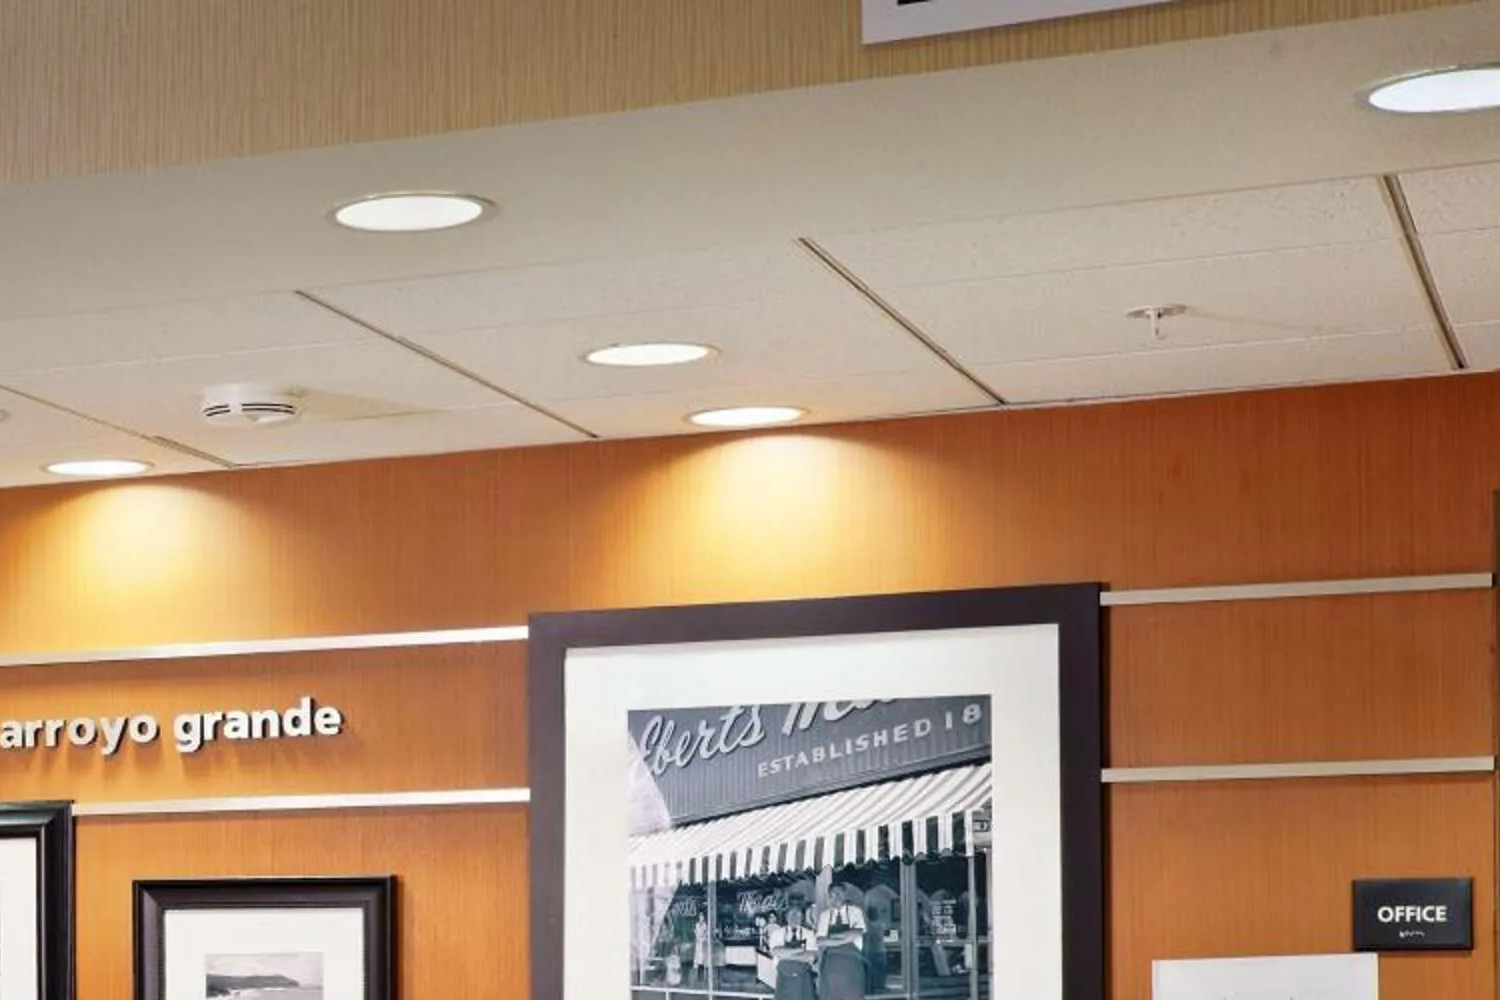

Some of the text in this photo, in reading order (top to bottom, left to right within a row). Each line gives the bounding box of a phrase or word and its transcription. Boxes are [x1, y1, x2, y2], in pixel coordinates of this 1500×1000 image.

[0, 714, 161, 755] arroyo
[173, 697, 343, 753] grande
[757, 718, 931, 778] ESTABLISHED
[1377, 905, 1448, 923] OFFICE
